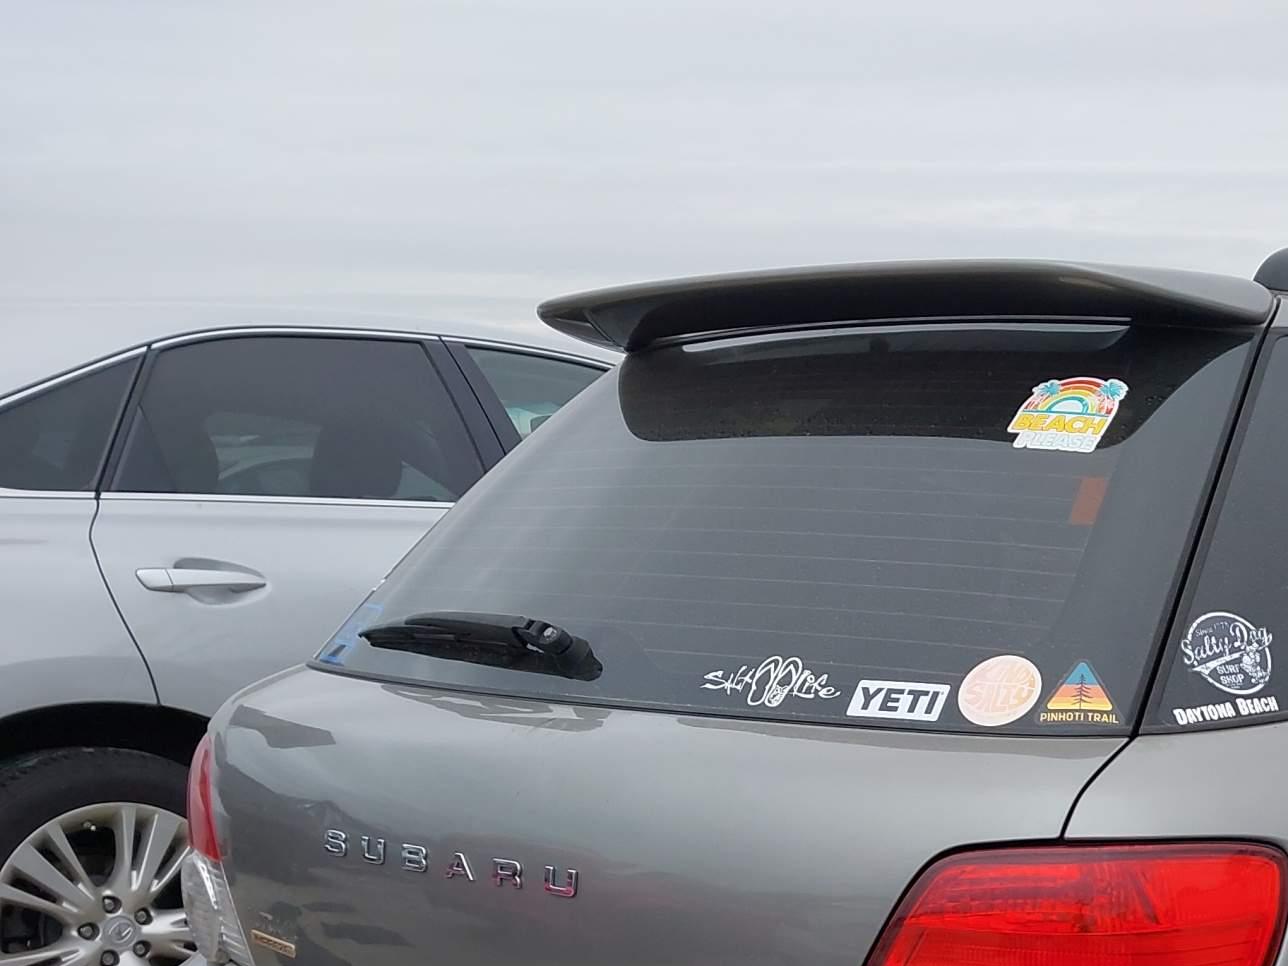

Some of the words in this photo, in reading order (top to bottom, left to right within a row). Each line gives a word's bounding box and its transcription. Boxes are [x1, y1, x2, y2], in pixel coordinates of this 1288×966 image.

[1012, 414, 1108, 435] BEACH
[1017, 432, 1097, 451] PLEASE
[1181, 635, 1231, 666] Salty
[1229, 621, 1273, 650] Dog
[1216, 664, 1240, 675] SURF
[1220, 674, 1245, 685] SHOP
[860, 686, 942, 715] YETI
[1172, 702, 1237, 725] DAYTONA
[1235, 696, 1279, 716] BEACH
[1039, 711, 1084, 723] PINHOTI
[1088, 713, 1119, 724] TRAIL
[324, 828, 580, 897] SUBARU
